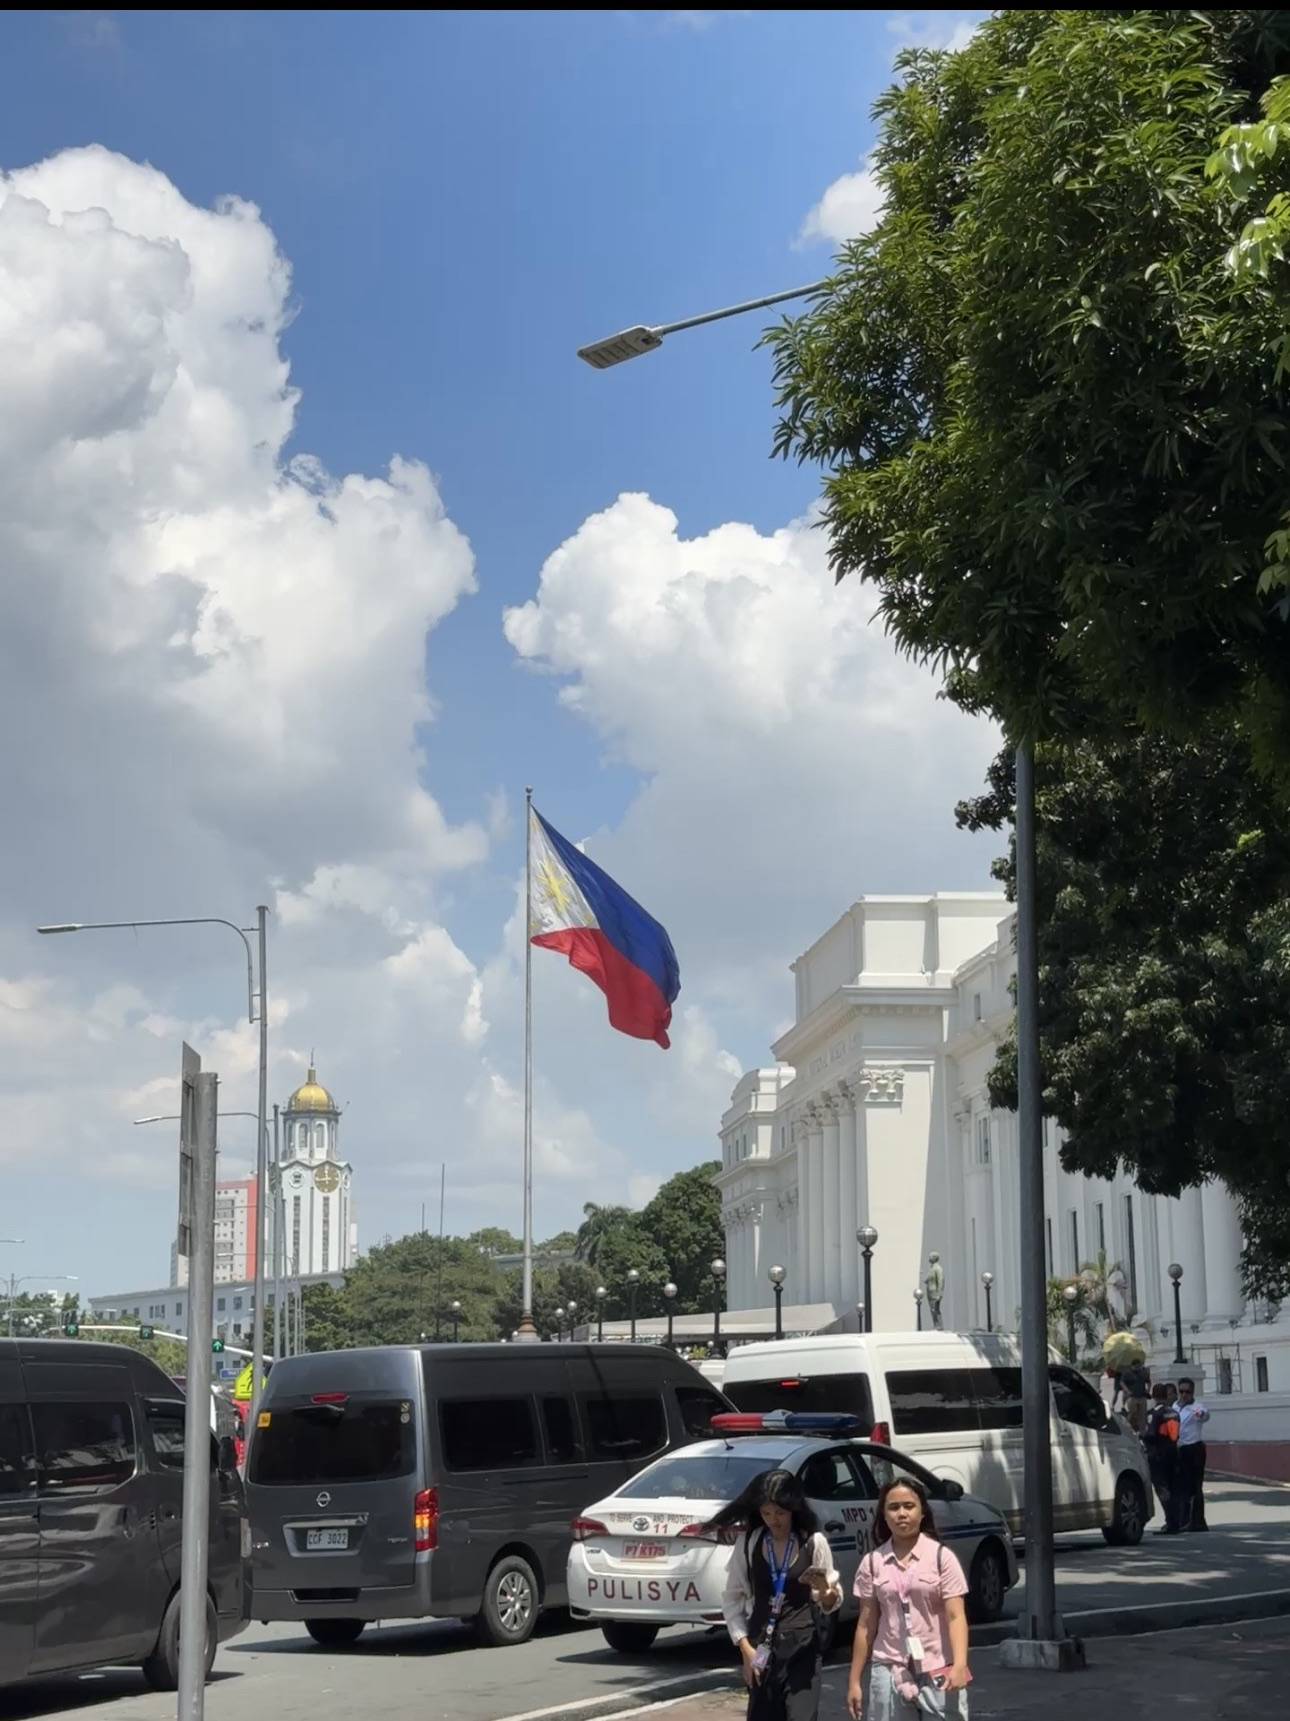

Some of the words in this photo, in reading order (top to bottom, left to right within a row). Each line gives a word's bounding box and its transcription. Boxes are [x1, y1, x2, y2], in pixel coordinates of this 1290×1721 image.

[653, 1514, 665, 1523] AND
[667, 1514, 694, 1525] PROTECT
[841, 1507, 867, 1523] MPD
[653, 1523, 668, 1534] 11
[327, 1532, 347, 1545] 3022
[587, 1578, 702, 1602] PULISYA
